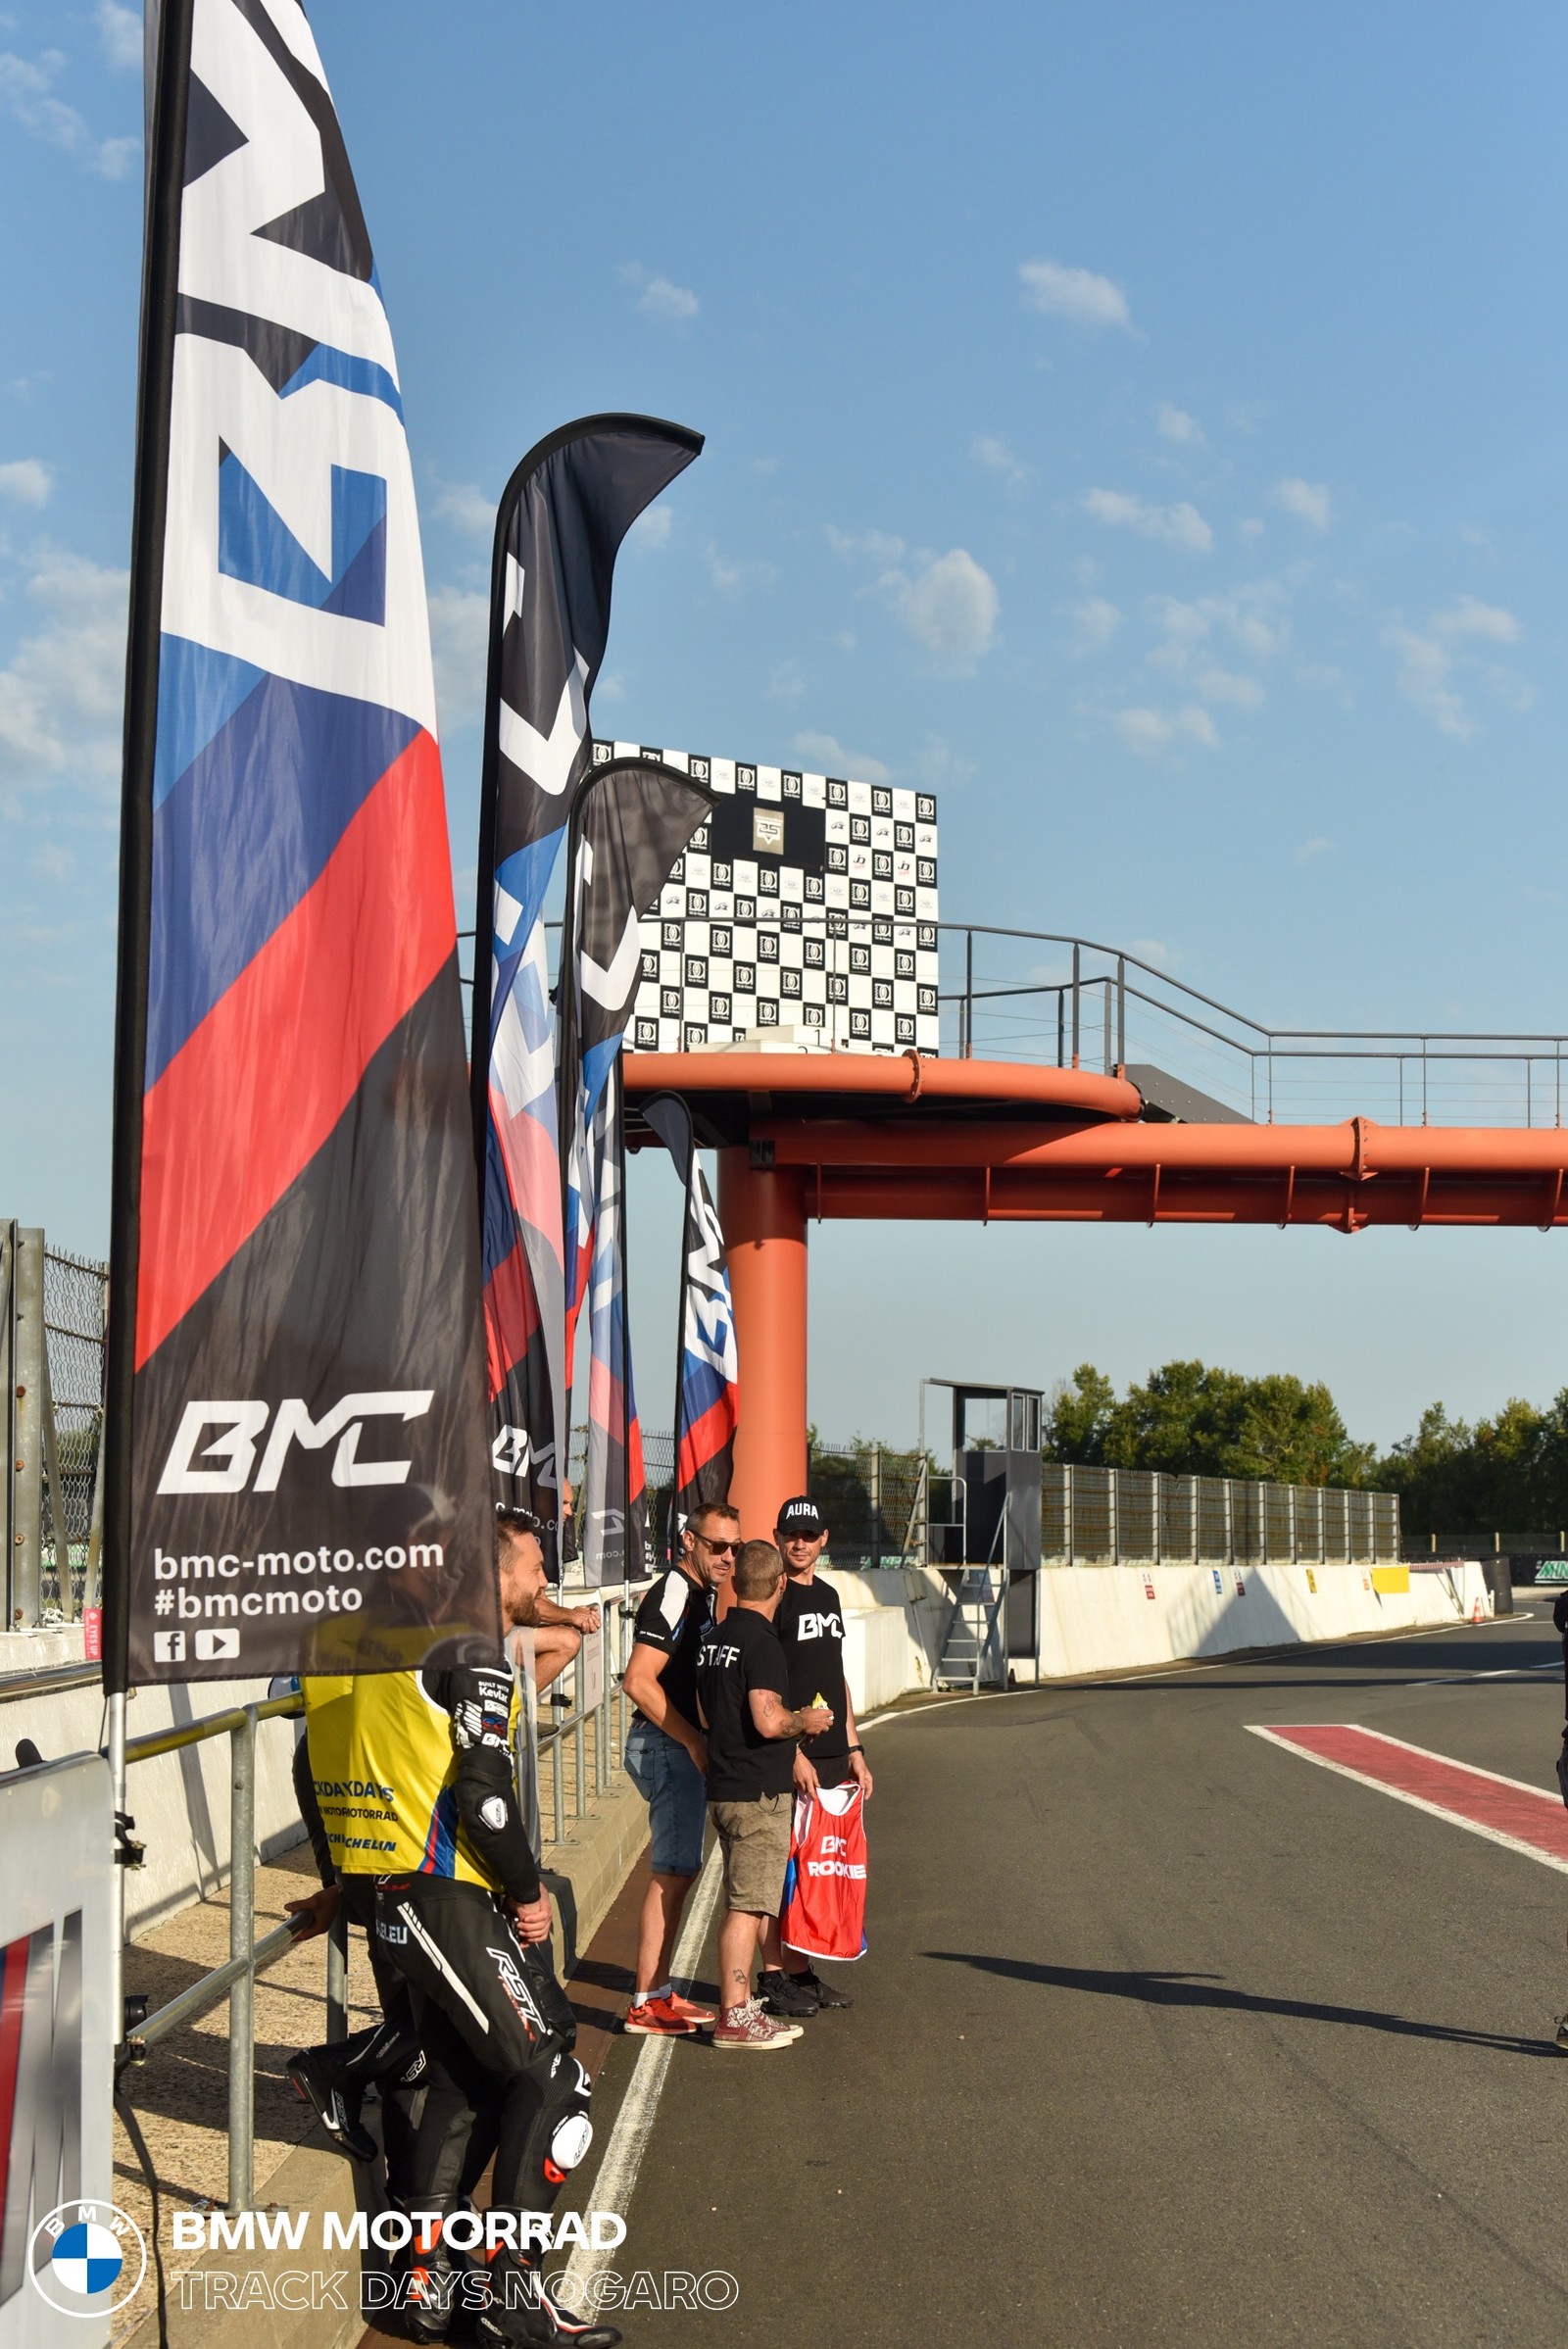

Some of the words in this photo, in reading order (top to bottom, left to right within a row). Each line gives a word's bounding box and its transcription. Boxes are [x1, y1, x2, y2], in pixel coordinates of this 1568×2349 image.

[156, 1390, 435, 1494] BMC
[786, 1502, 819, 1520] AURA
[154, 1543, 444, 1580] bmc-moto.com
[154, 1585, 363, 1619] #bmcmoto
[797, 1612, 843, 1641] BMC
[820, 1835, 847, 1857] BMC
[808, 1860, 867, 1880] ROOKIE
[485, 1947, 547, 2034] RST
